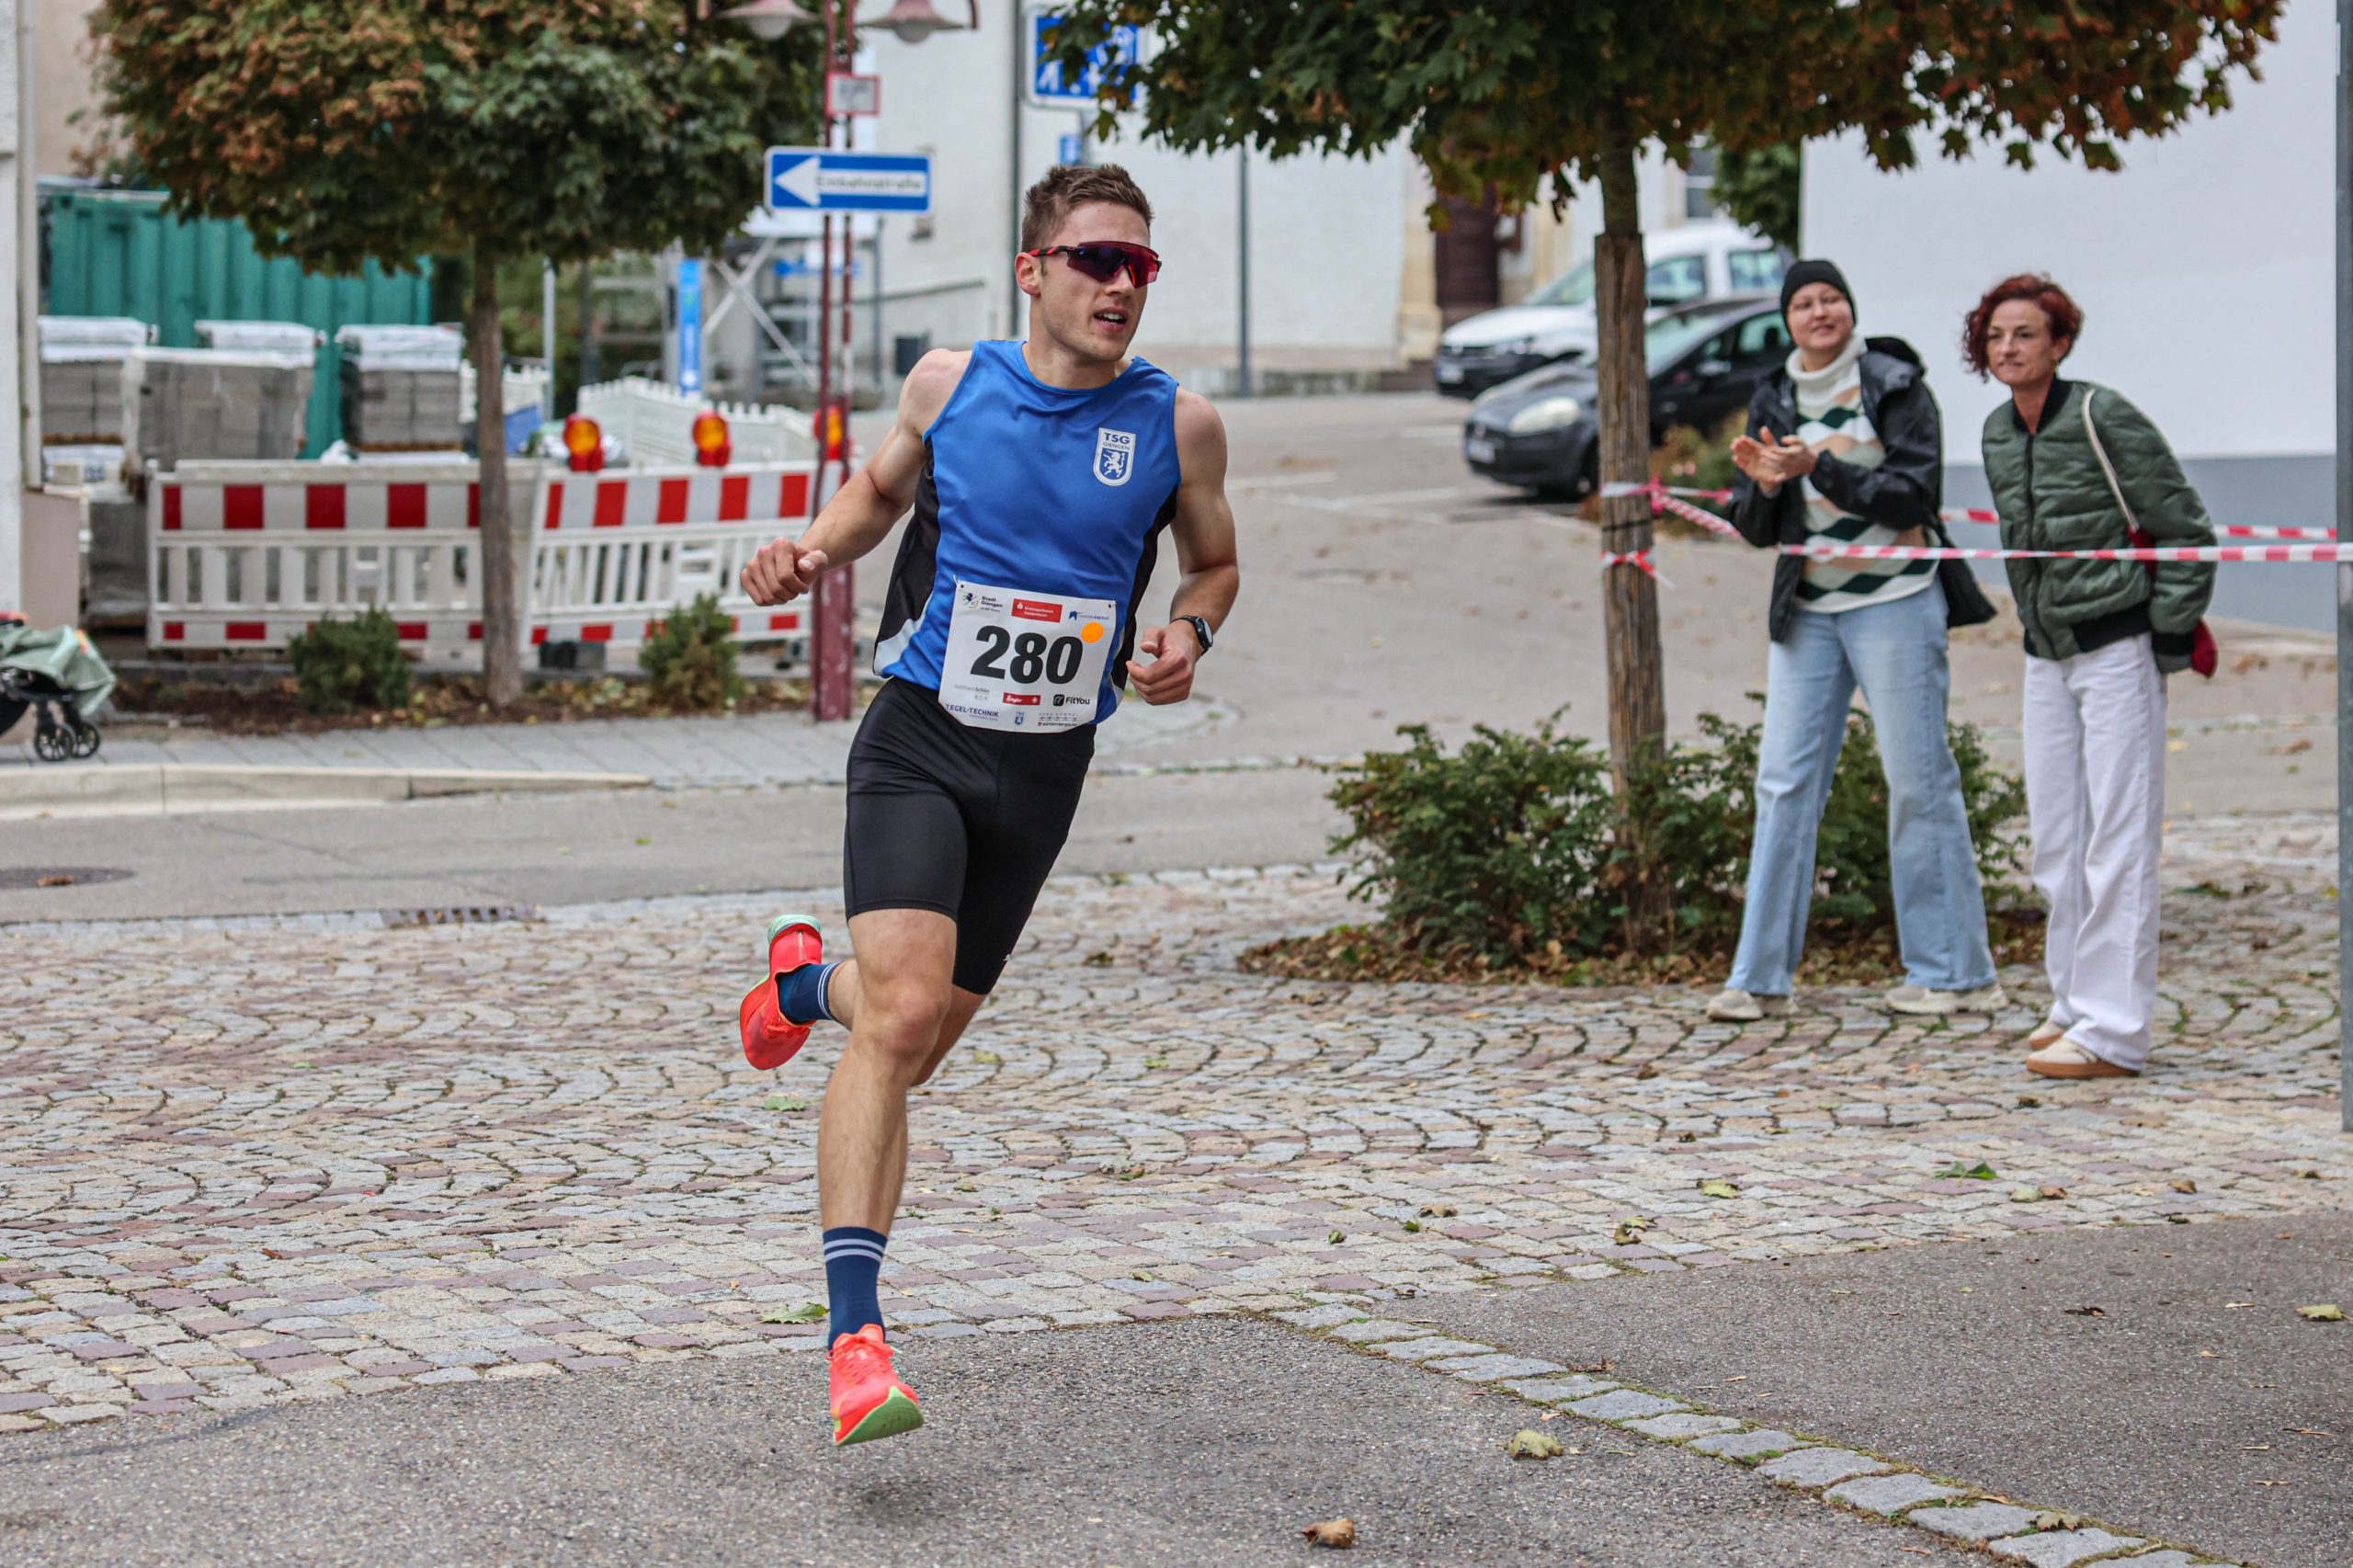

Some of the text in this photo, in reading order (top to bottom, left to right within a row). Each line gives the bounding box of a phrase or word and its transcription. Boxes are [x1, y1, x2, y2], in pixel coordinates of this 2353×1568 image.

[1104, 432, 1131, 445] TSG
[1103, 442, 1131, 450] GIENGEN
[971, 625, 1083, 684] 280
[1065, 697, 1090, 705] FitYou
[945, 703, 999, 717] TEGEL-TECHNIK
